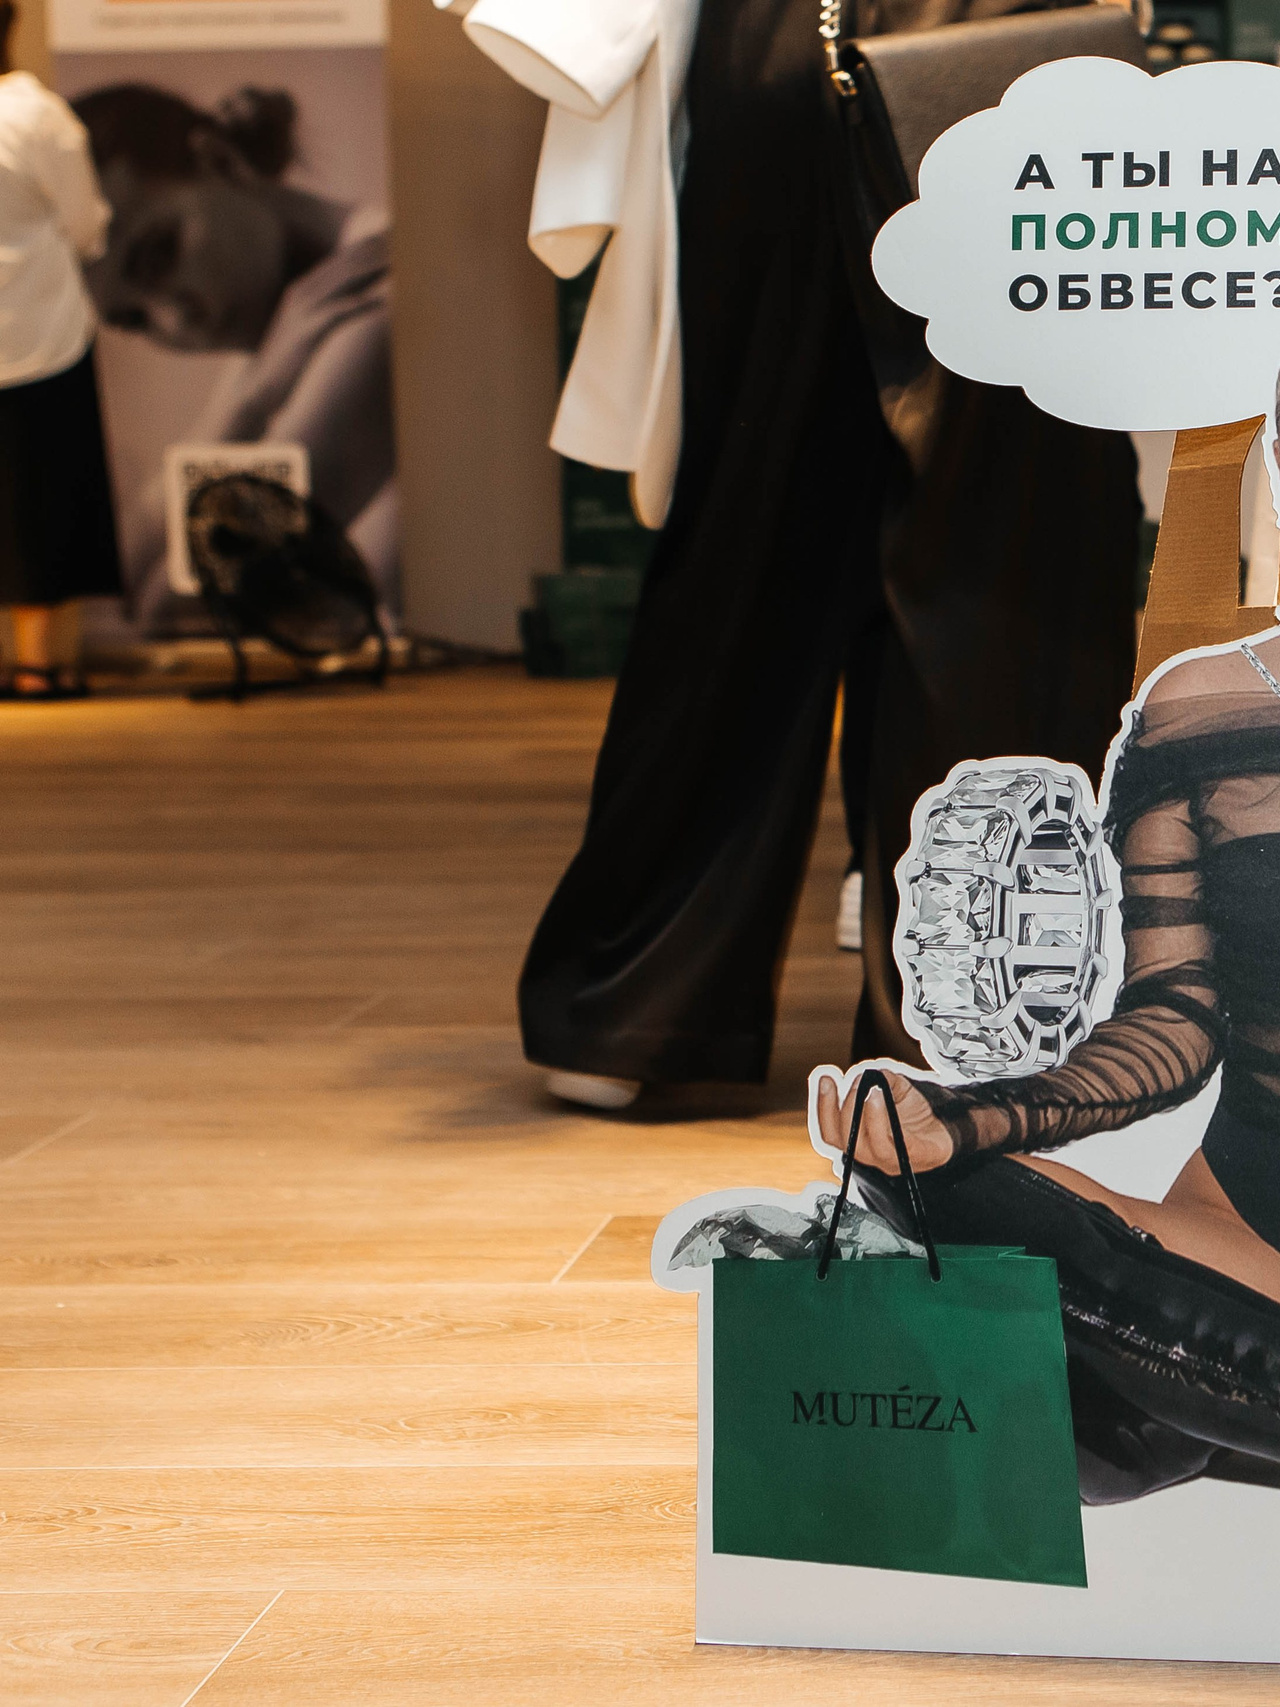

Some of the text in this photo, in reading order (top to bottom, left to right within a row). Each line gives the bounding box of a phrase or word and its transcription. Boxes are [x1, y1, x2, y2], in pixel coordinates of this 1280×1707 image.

[1014, 154, 1055, 190] А
[1082, 151, 1169, 188] ТЫ
[791, 1385, 977, 1433] MUTÉZA
